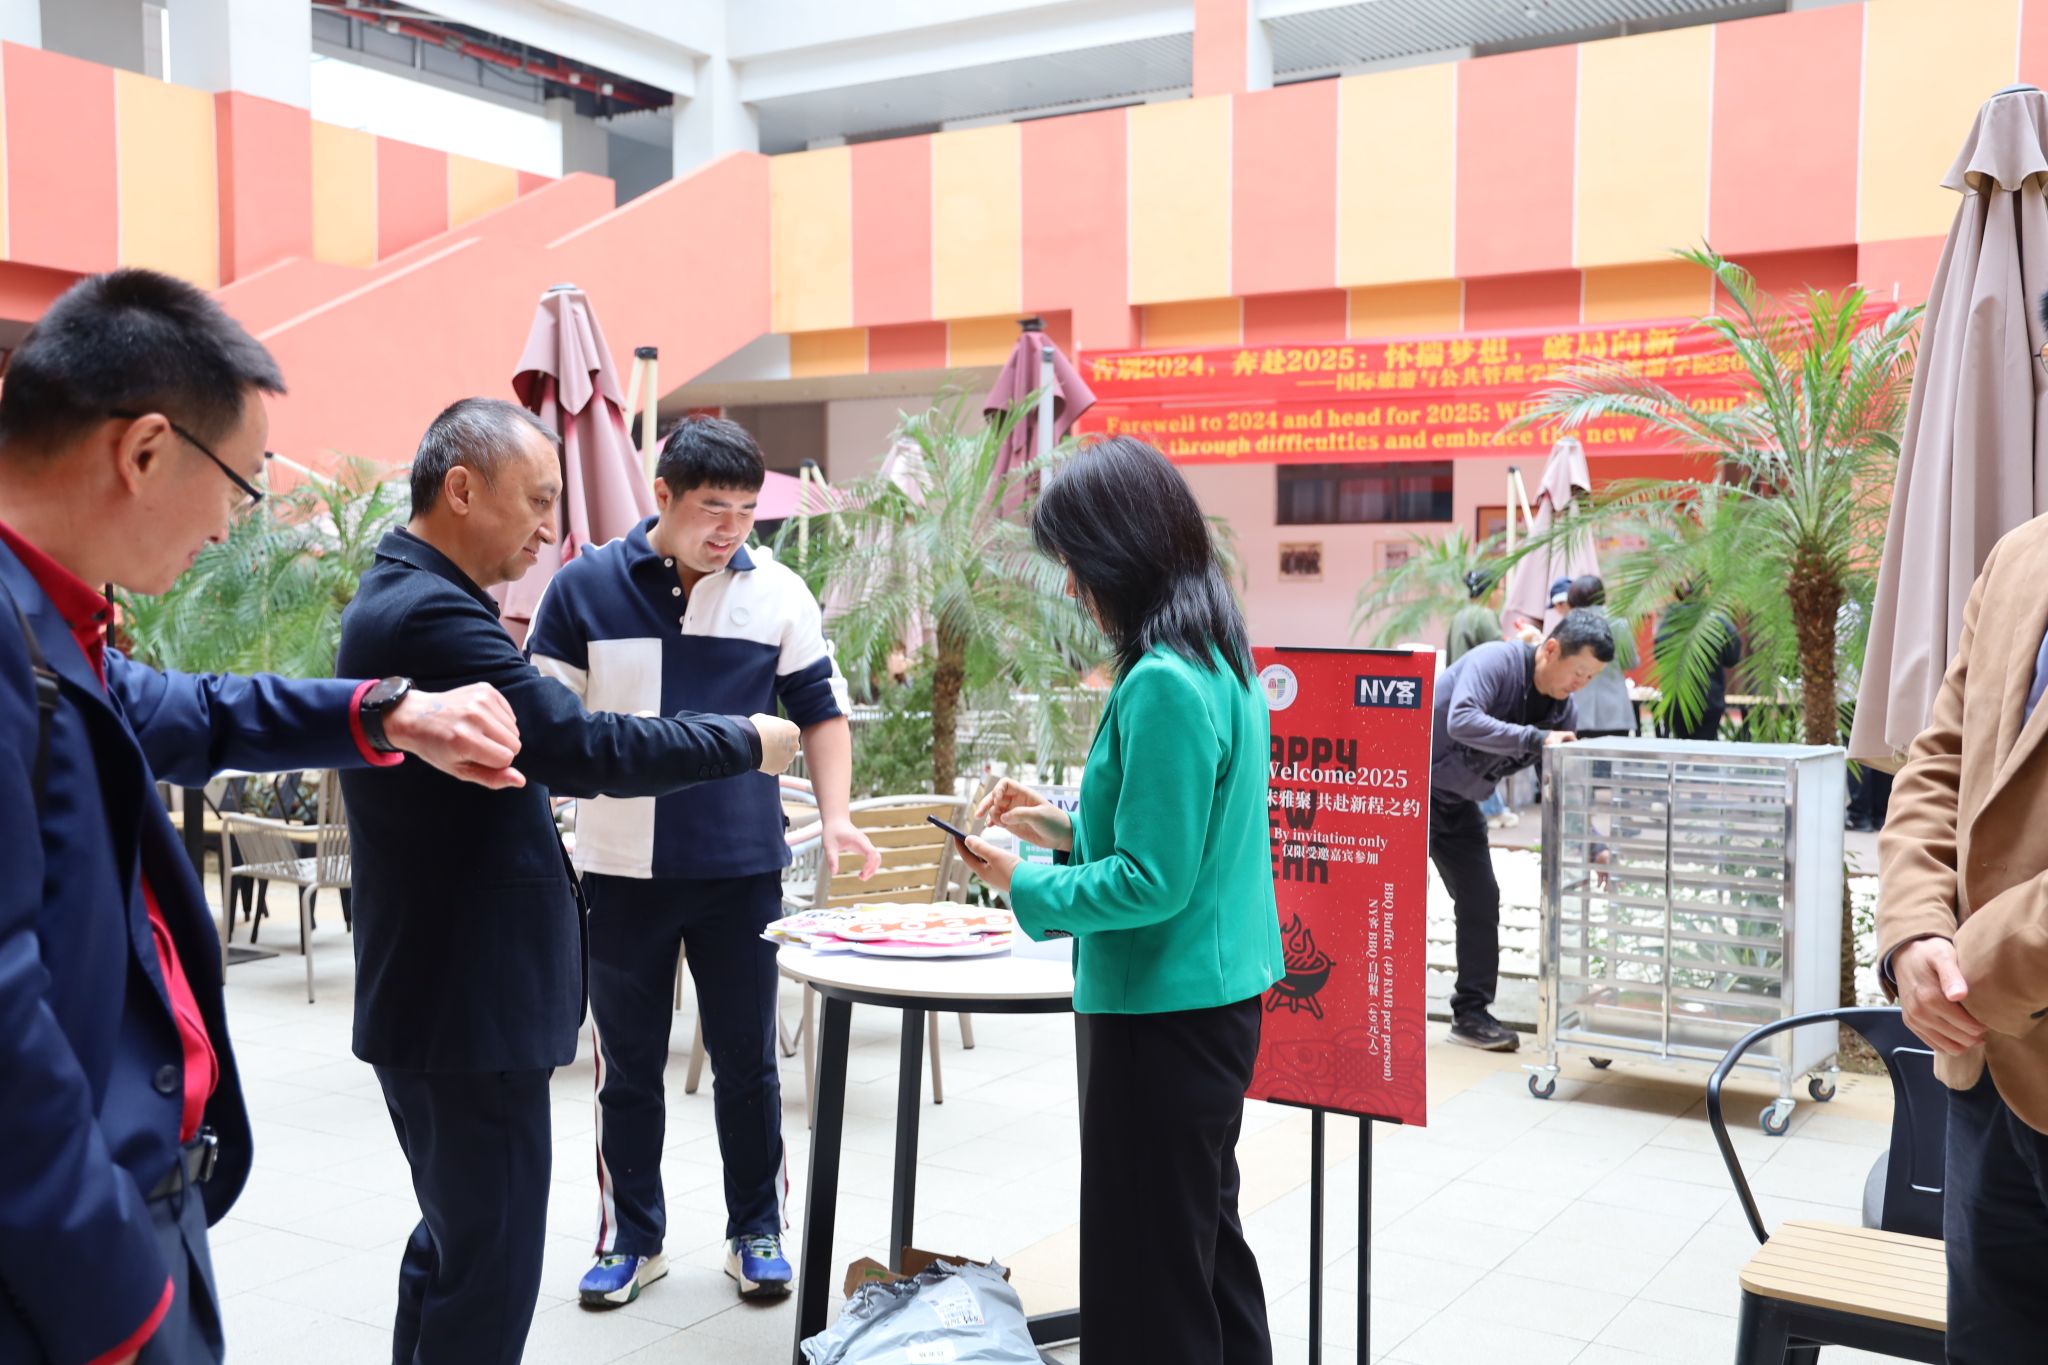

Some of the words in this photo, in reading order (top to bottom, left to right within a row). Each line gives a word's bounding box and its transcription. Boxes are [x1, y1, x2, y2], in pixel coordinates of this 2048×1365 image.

[1106, 414, 1195, 434] Farewell
[1201, 416, 1223, 431] to
[1227, 411, 1278, 431] 2024
[1283, 409, 1322, 429] and
[1328, 407, 1381, 428] head
[1386, 405, 1421, 426] for
[1426, 402, 1490, 425] 2025:
[1170, 435, 1250, 458] through
[1255, 430, 1380, 454] difficulties
[1385, 430, 1427, 450] and
[1586, 426, 1638, 444] new
[1360, 678, 1416, 705] NY客
[1269, 734, 1358, 781] APPY
[1316, 792, 1421, 819] 共赴新程之约
[1274, 827, 1290, 844] By
[1293, 828, 1356, 846] invitation
[1358, 834, 1389, 852] only
[1282, 844, 1380, 865] 仅限受邀嘉宾参加
[1382, 882, 1394, 909] BBQ
[1383, 912, 1395, 950] Buffet
[1366, 932, 1378, 958] BBQ
[1383, 978, 1393, 1008] RMB
[1381, 1010, 1391, 1032] per
[1381, 1034, 1394, 1081] person)
